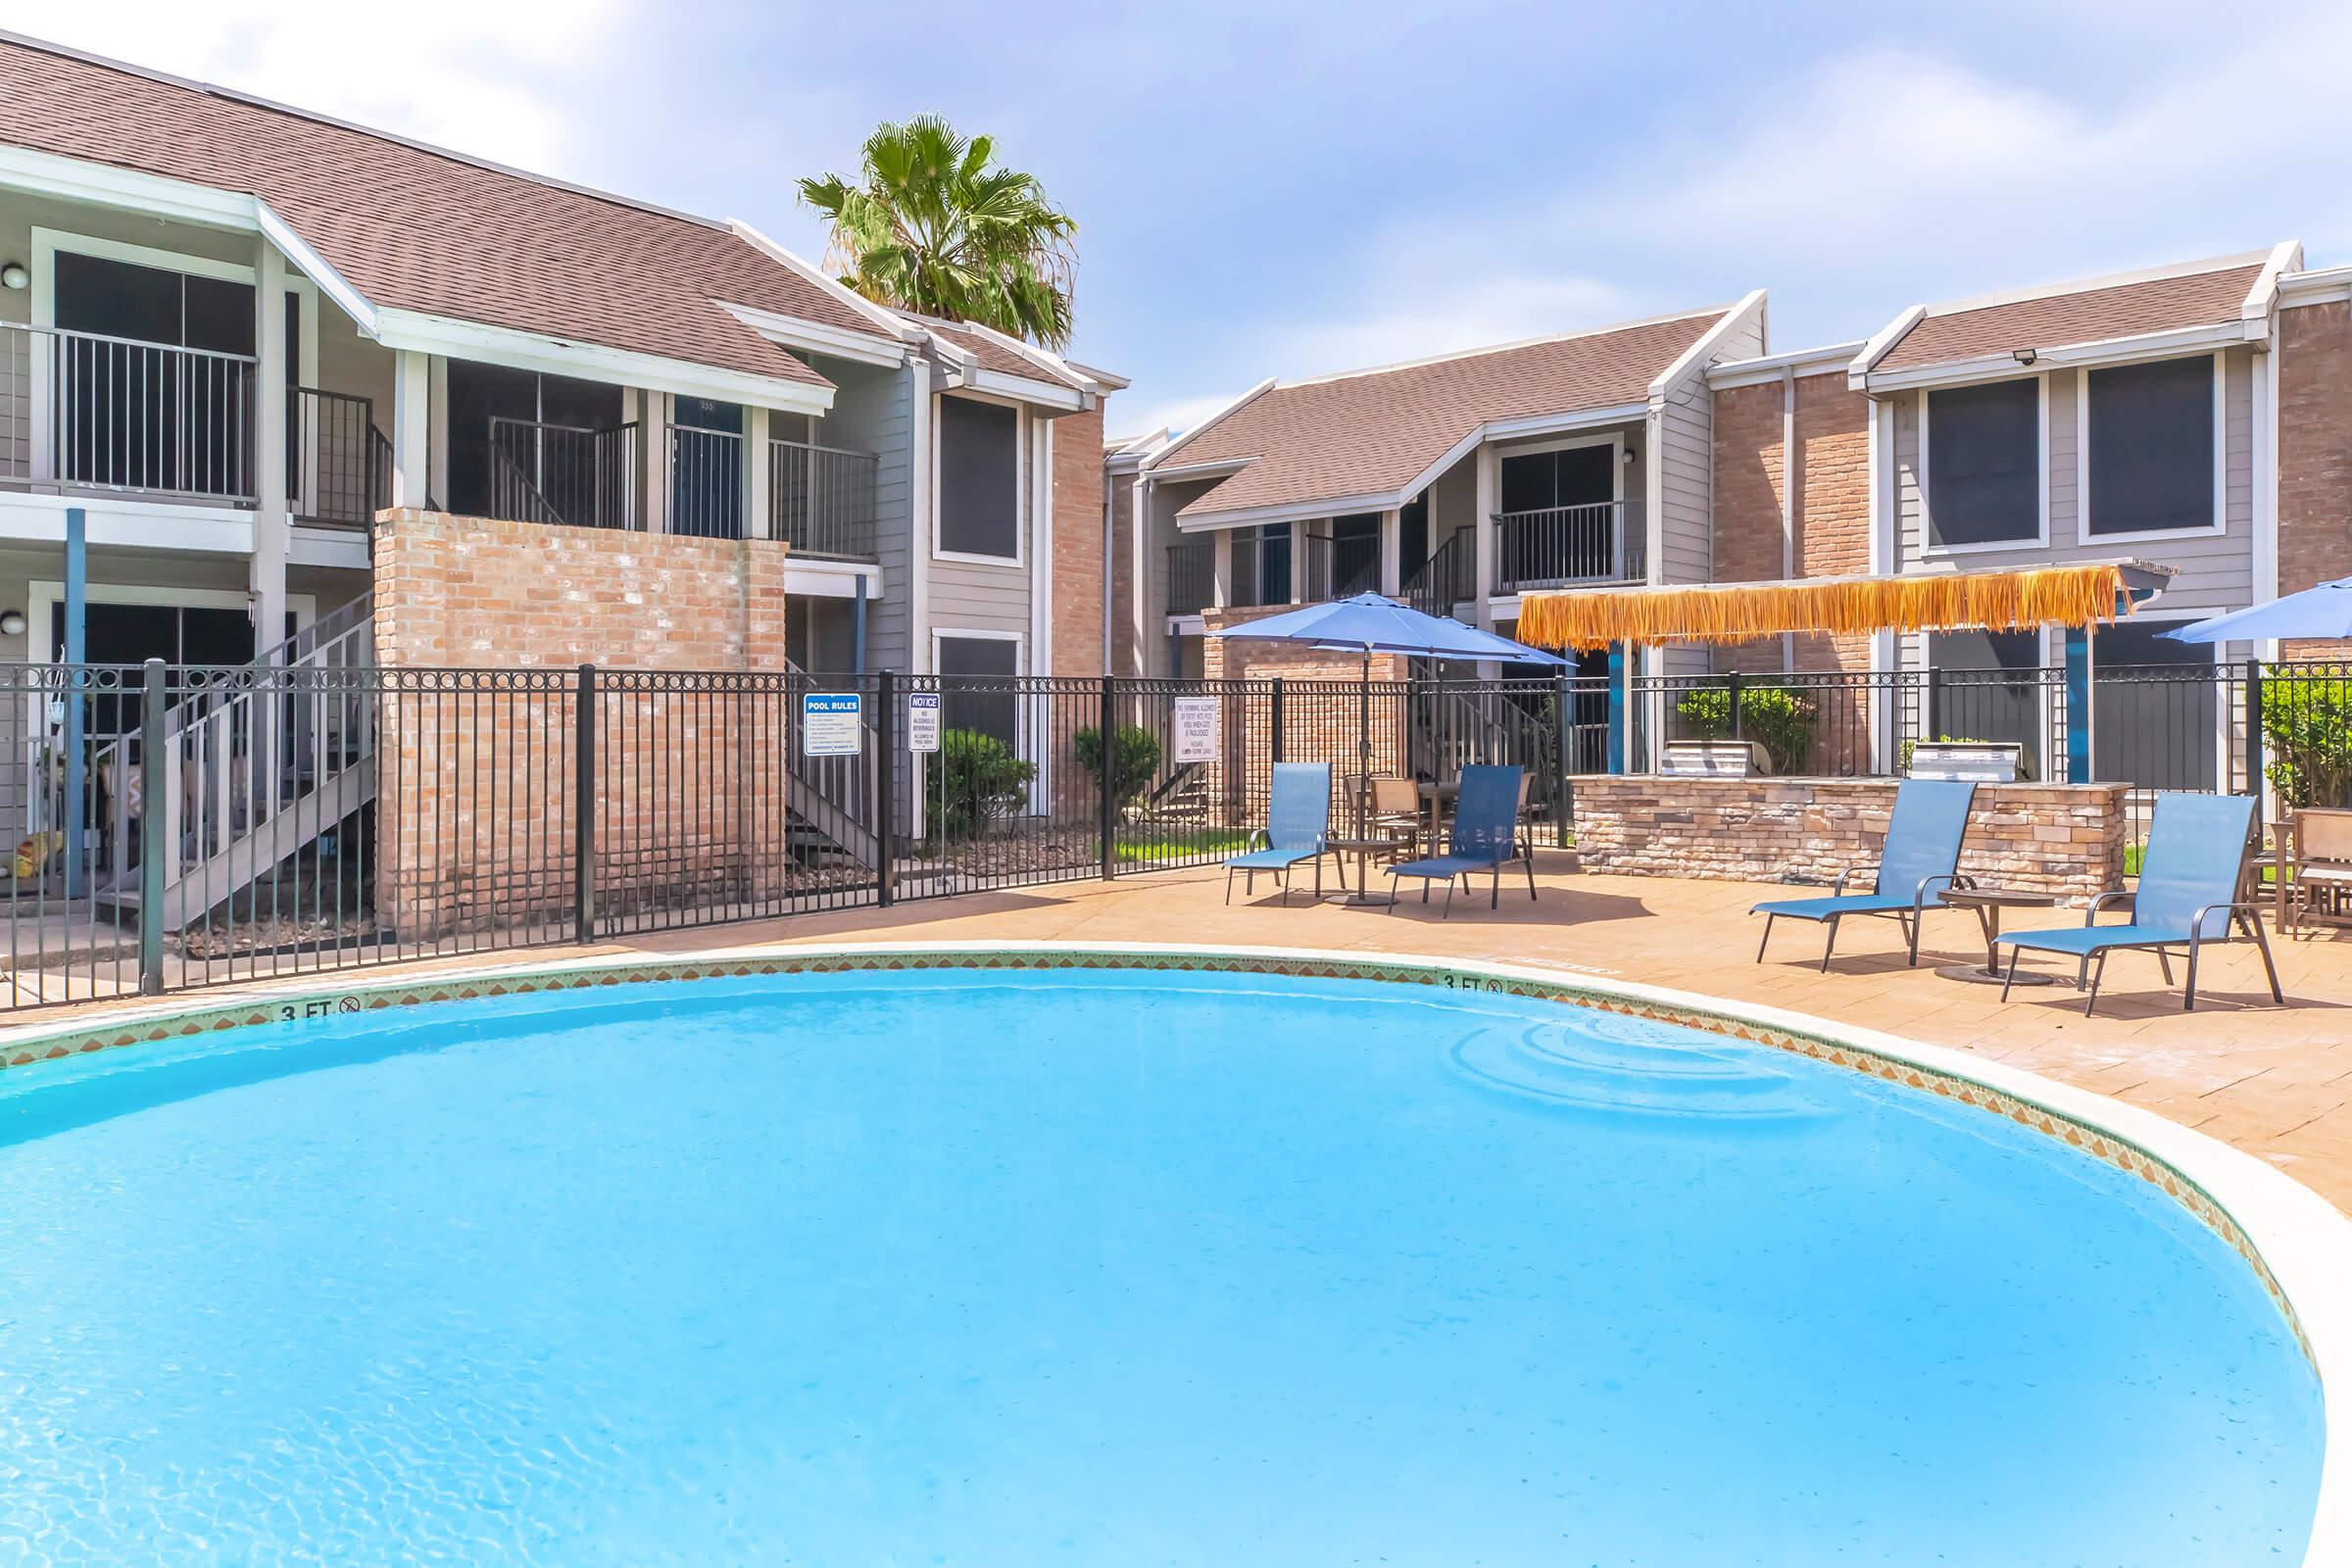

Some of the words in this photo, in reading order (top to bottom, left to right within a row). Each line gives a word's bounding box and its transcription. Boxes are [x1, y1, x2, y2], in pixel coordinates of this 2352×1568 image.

[911, 697, 938, 707] NOTICE
[1445, 975, 1454, 988] 3
[1462, 977, 1481, 990] FT
[281, 1005, 296, 1021] 3
[306, 1001, 331, 1018] FT
